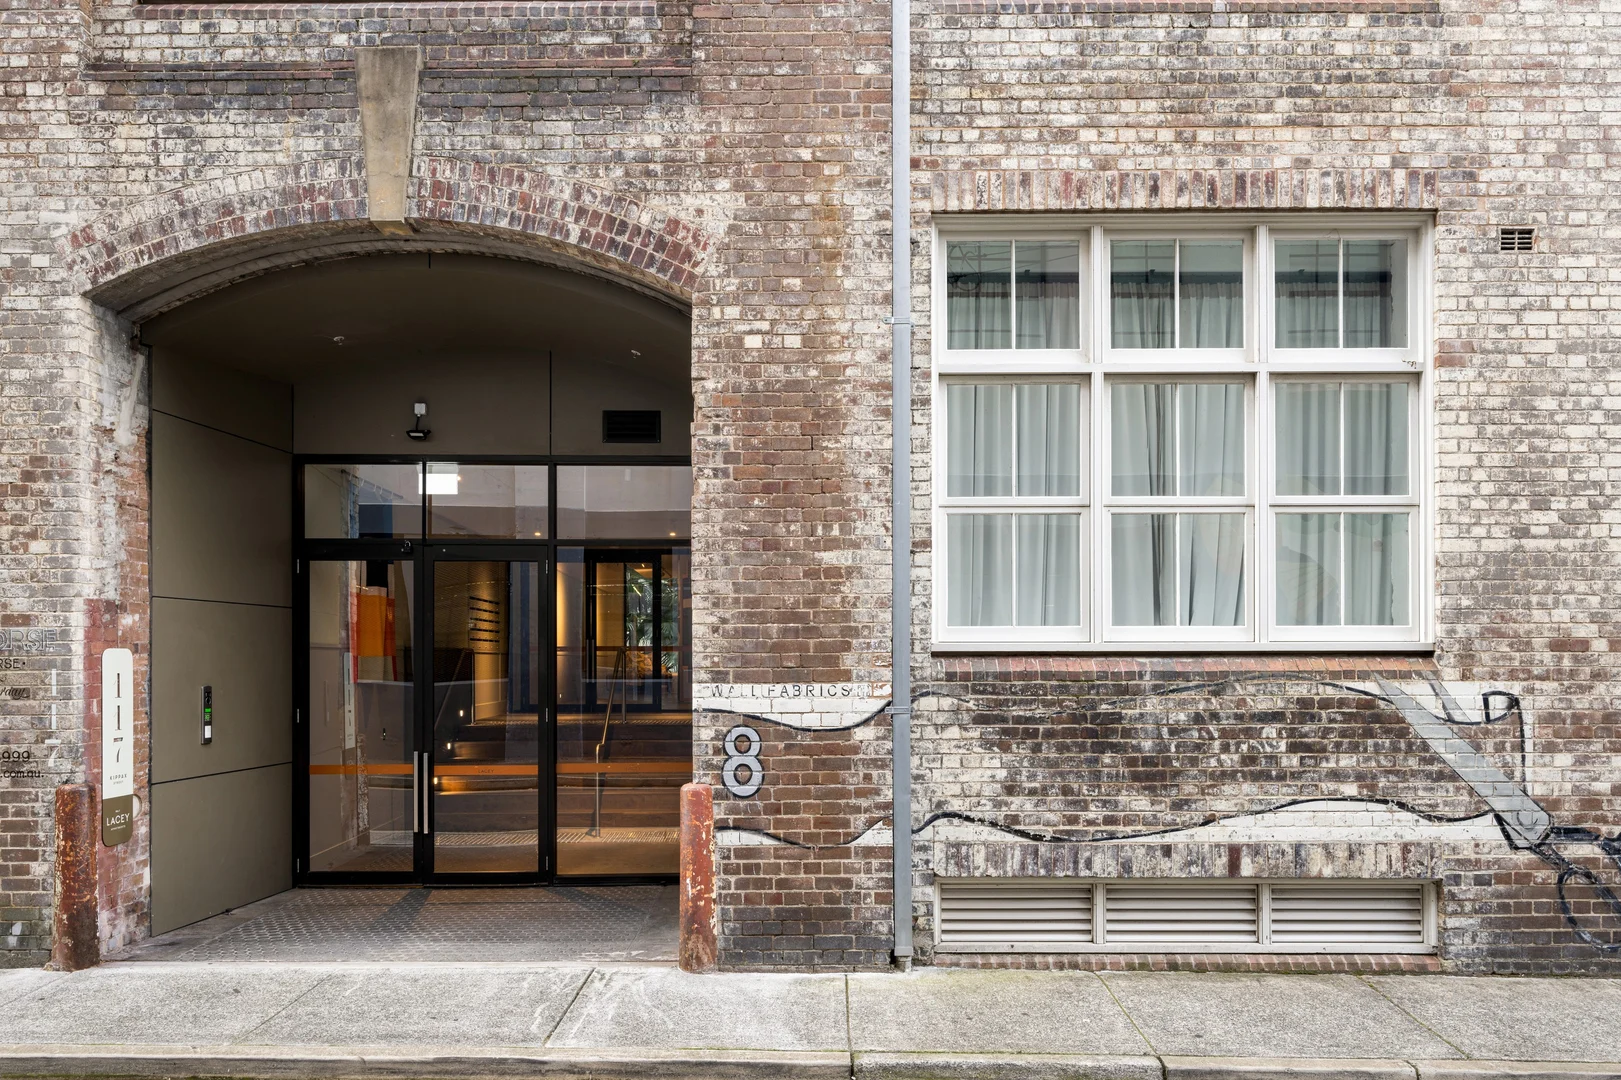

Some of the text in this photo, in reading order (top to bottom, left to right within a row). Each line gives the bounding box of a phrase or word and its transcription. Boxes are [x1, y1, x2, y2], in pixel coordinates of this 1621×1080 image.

[768, 684, 850, 697] FABRICS
[721, 724, 765, 798] 8
[106, 812, 131, 827] LACEY
